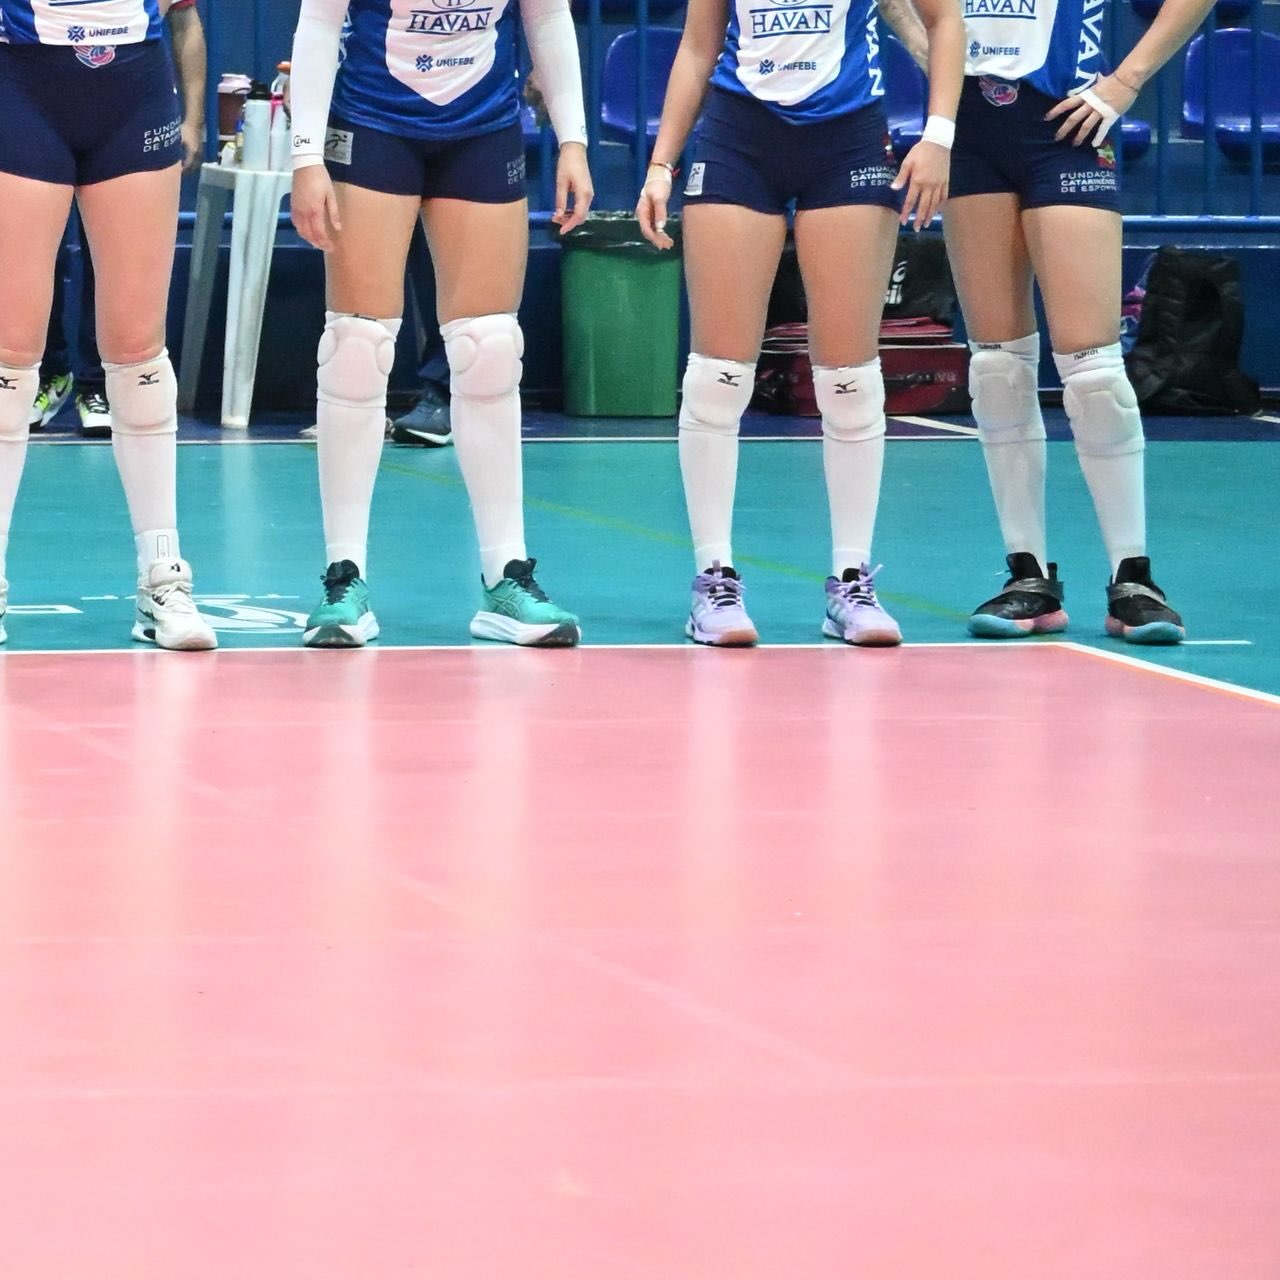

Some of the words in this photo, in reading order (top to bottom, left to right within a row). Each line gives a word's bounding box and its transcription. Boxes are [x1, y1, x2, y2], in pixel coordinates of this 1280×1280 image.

[408, 11, 491, 32] HAVAN
[751, 9, 833, 34] HAVAN
[89, 26, 129, 37] UNIFEBE
[982, 46, 1021, 56] UNIFEBE
[436, 57, 475, 67] UNIFEBE
[142, 143, 159, 153] DE
[1059, 170, 1116, 180] FUNDAÇÃO
[850, 180, 865, 188] DE
[1060, 185, 1076, 193] DE
